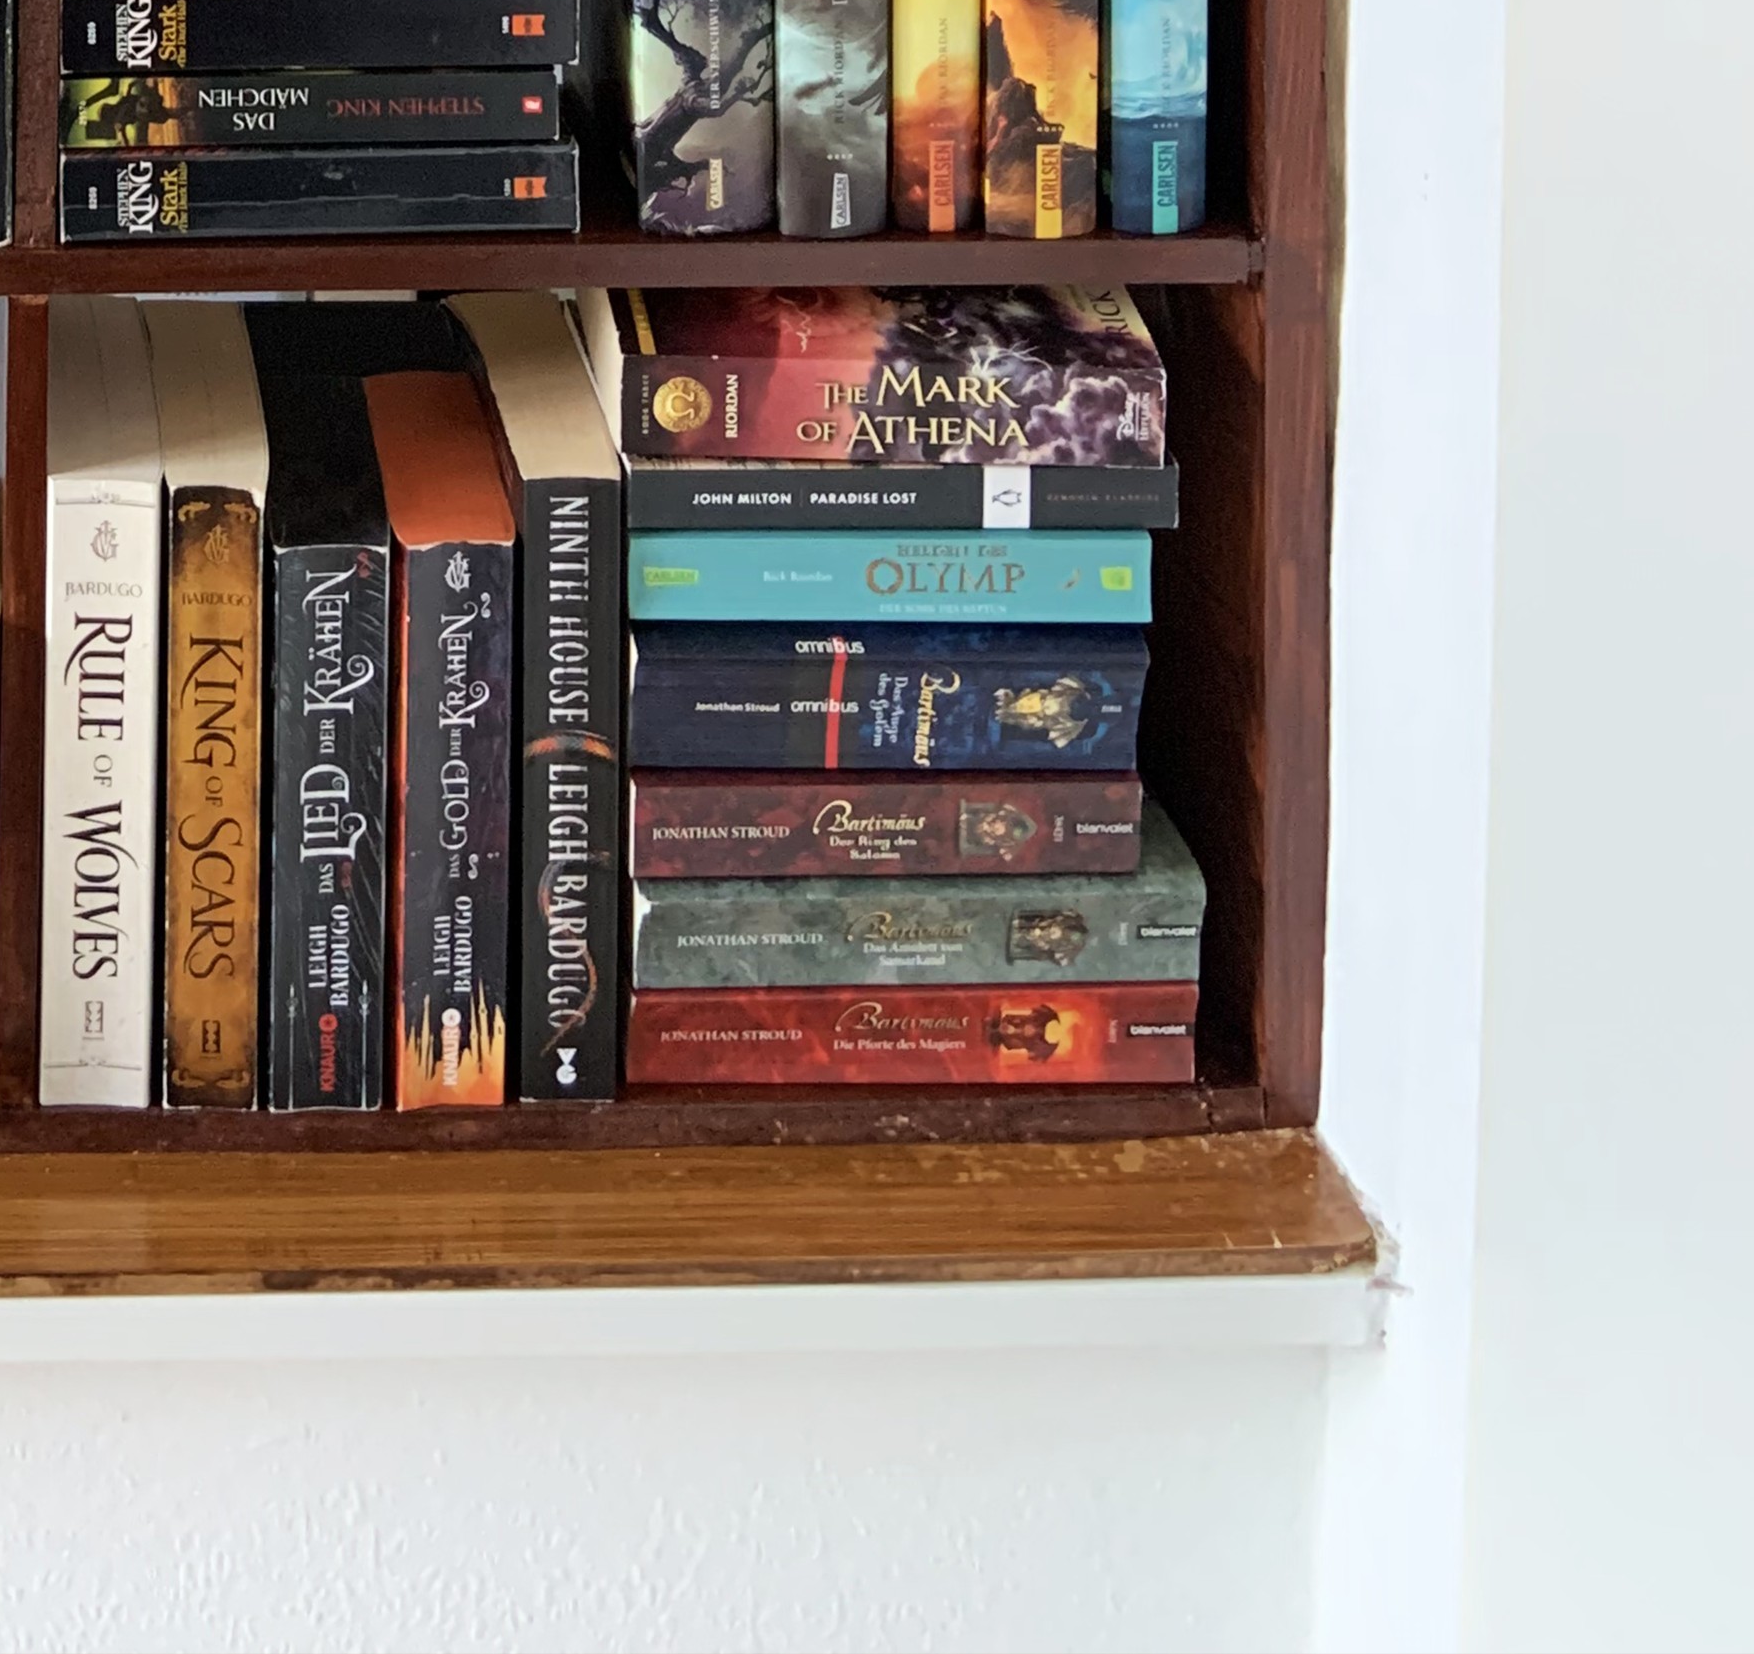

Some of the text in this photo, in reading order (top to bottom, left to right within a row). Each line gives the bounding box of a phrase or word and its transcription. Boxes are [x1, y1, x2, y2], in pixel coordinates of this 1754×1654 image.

[198, 87, 309, 108] MÄDCHEN
[233, 113, 274, 131] DAS
[823, 365, 1020, 408] THE MARK
[726, 375, 738, 438] RIORDAN
[797, 412, 1028, 453] OF ATHENA
[692, 493, 916, 505] JOHN MILTON PARADISE LOST
[865, 558, 1025, 594] OLYMP
[791, 698, 859, 714] omnibus
[547, 495, 589, 1028] NINTH HOUSE LEIGH BARDUGO
[63, 612, 138, 980] RULE OF WOLVES
[652, 825, 790, 840] JONATHAN STROUD
[812, 799, 926, 834] Bartimäus
[1076, 823, 1132, 835] blanvalet
[321, 1029, 335, 1091] KNAUR
